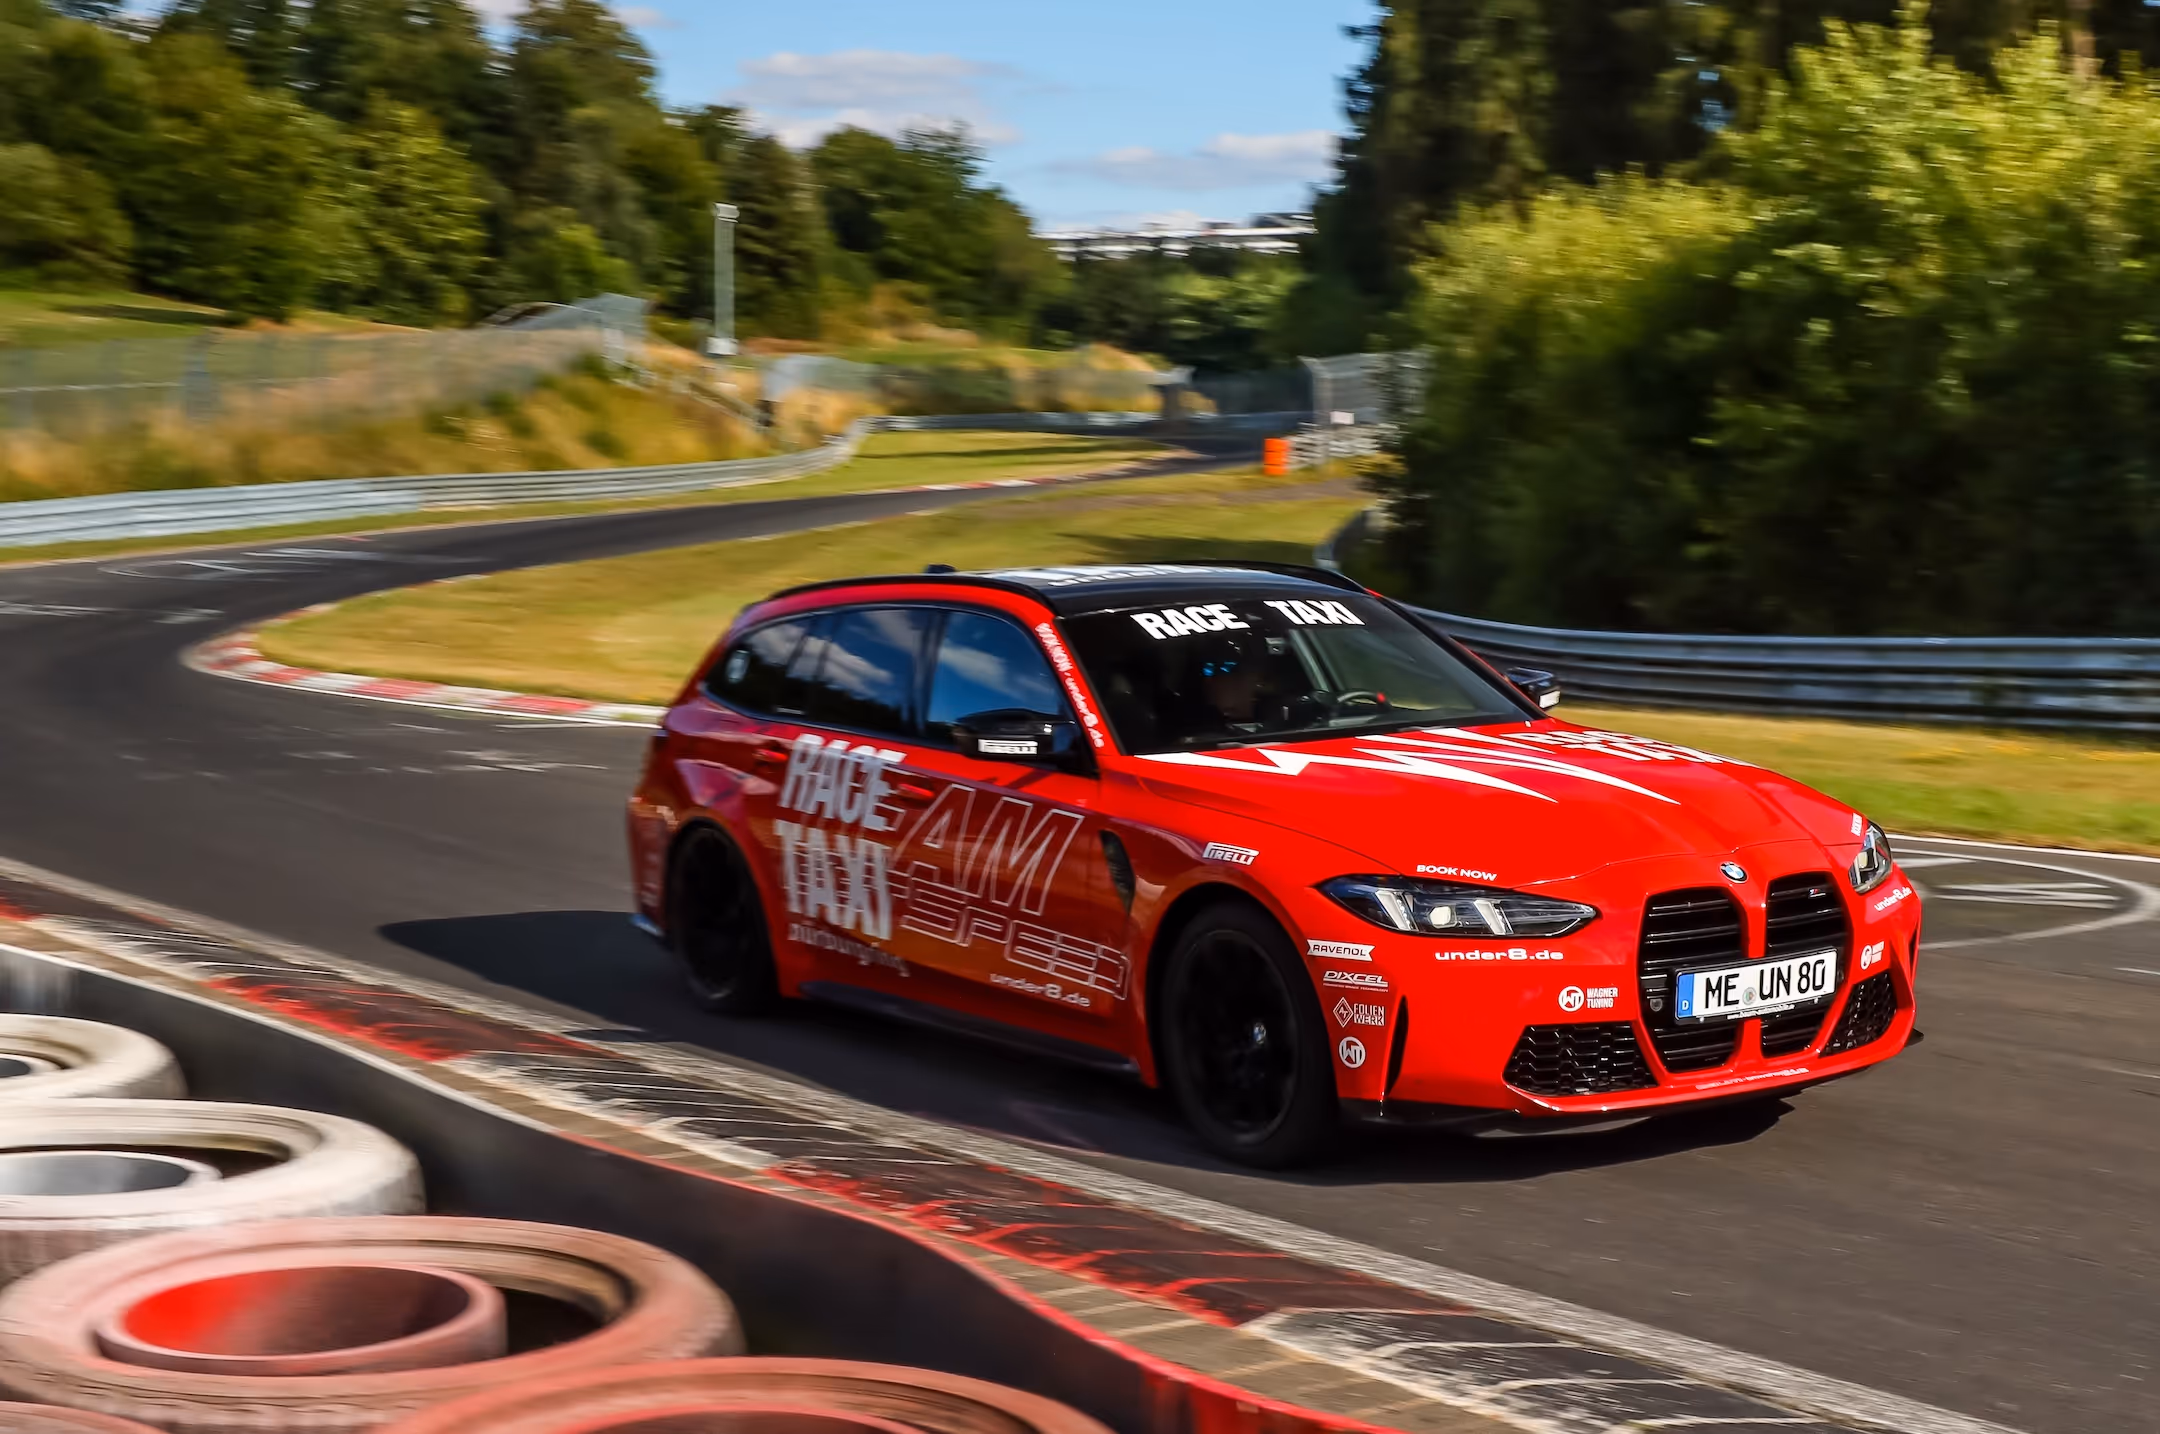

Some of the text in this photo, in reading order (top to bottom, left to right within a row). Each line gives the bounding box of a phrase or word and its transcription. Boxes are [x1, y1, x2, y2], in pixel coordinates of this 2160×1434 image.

[1130, 600, 1366, 640] RACE TAXI
[778, 734, 908, 832] RACE
[1202, 841, 1260, 866] PIRELLI
[773, 819, 893, 940] TAXI
[1416, 864, 1497, 881] BOOK NOW
[1874, 886, 1912, 912] under8.de
[1312, 944, 1367, 957] RAVENOL
[1434, 947, 1564, 961] under8.de
[1323, 970, 1387, 985] DIXCEL
[1705, 958, 1826, 1009] ME UN 80
[989, 973, 1091, 1008] under8.de
[1586, 986, 1619, 998] WAGNER
[1353, 1003, 1385, 1016] FOLIEN
[1586, 997, 1614, 1009] TUNING
[1681, 999, 1690, 1011] D
[1353, 1013, 1385, 1026] WERK
